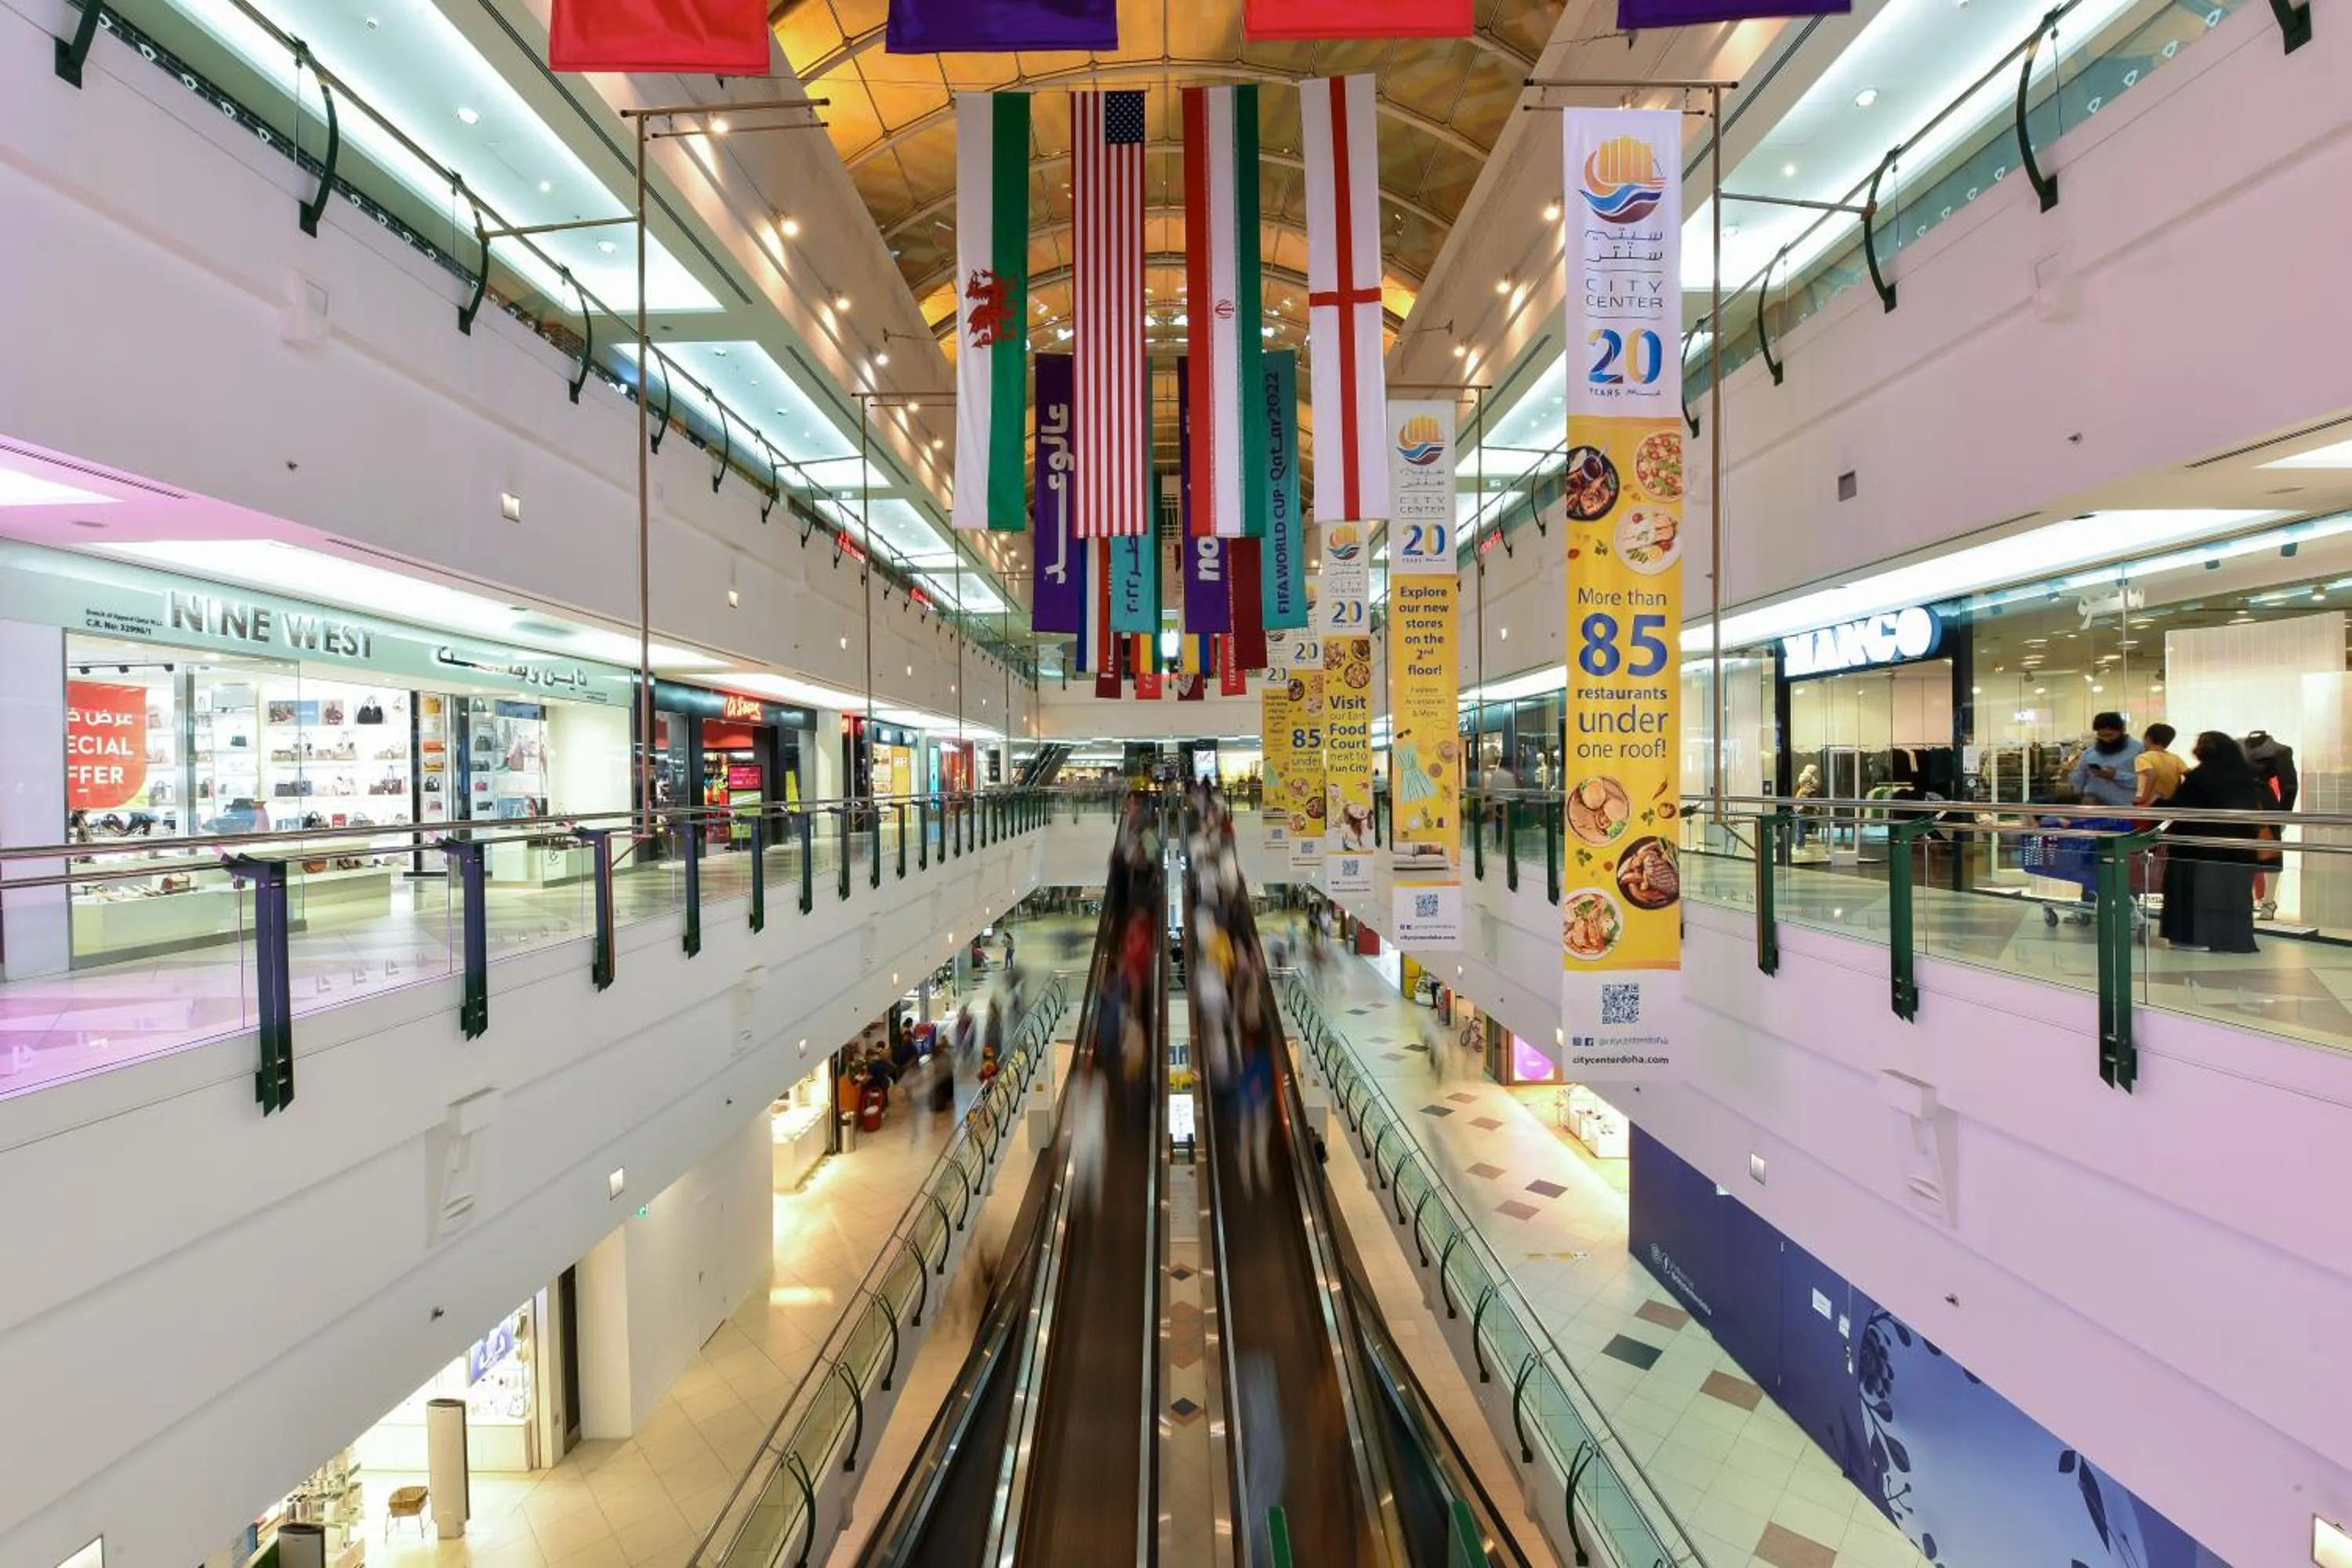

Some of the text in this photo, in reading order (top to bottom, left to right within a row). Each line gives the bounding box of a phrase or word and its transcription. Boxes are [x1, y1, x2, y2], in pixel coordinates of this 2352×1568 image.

[1586, 278, 1664, 293] CITY
[1586, 295, 1664, 308] CENTER
[1587, 327, 1663, 384] 20
[1588, 387, 1621, 397] YEARS
[1265, 371, 1290, 615] FIFA WORLD CUP Qatar2022
[1399, 495, 1445, 504] CITY
[1399, 505, 1445, 514] CENTER
[1403, 523, 1445, 556] 20
[1197, 535, 1221, 582] no
[1399, 586, 1448, 600] Explore
[1577, 588, 1667, 606] More than
[1330, 601, 1363, 623] 20
[1399, 604, 1449, 613] our new
[169, 591, 372, 658] NINE WEST
[1406, 619, 1443, 629] stores
[1405, 633, 1445, 644] on the
[1578, 612, 1668, 677] 85
[1782, 606, 1936, 678] MANGO
[1294, 642, 1318, 659] 20
[1416, 647, 1434, 661] 2nd
[1408, 665, 1443, 676] floor!
[1577, 687, 1668, 700] restaurants
[1330, 695, 1367, 710] Visit
[85, 708, 133, 728] عرض
[1579, 704, 1668, 733] under
[1330, 722, 1367, 735] Food
[68, 735, 134, 756] ECIAL
[1292, 728, 1321, 748] 85
[1330, 738, 1367, 750] Court
[1577, 739, 1667, 758] one roof!
[1331, 753, 1355, 761] next
[68, 765, 124, 785] FFER
[1330, 764, 1347, 772] Fun
[1349, 764, 1367, 773] City
[1572, 1055, 1670, 1065] citycenterdoha.com
